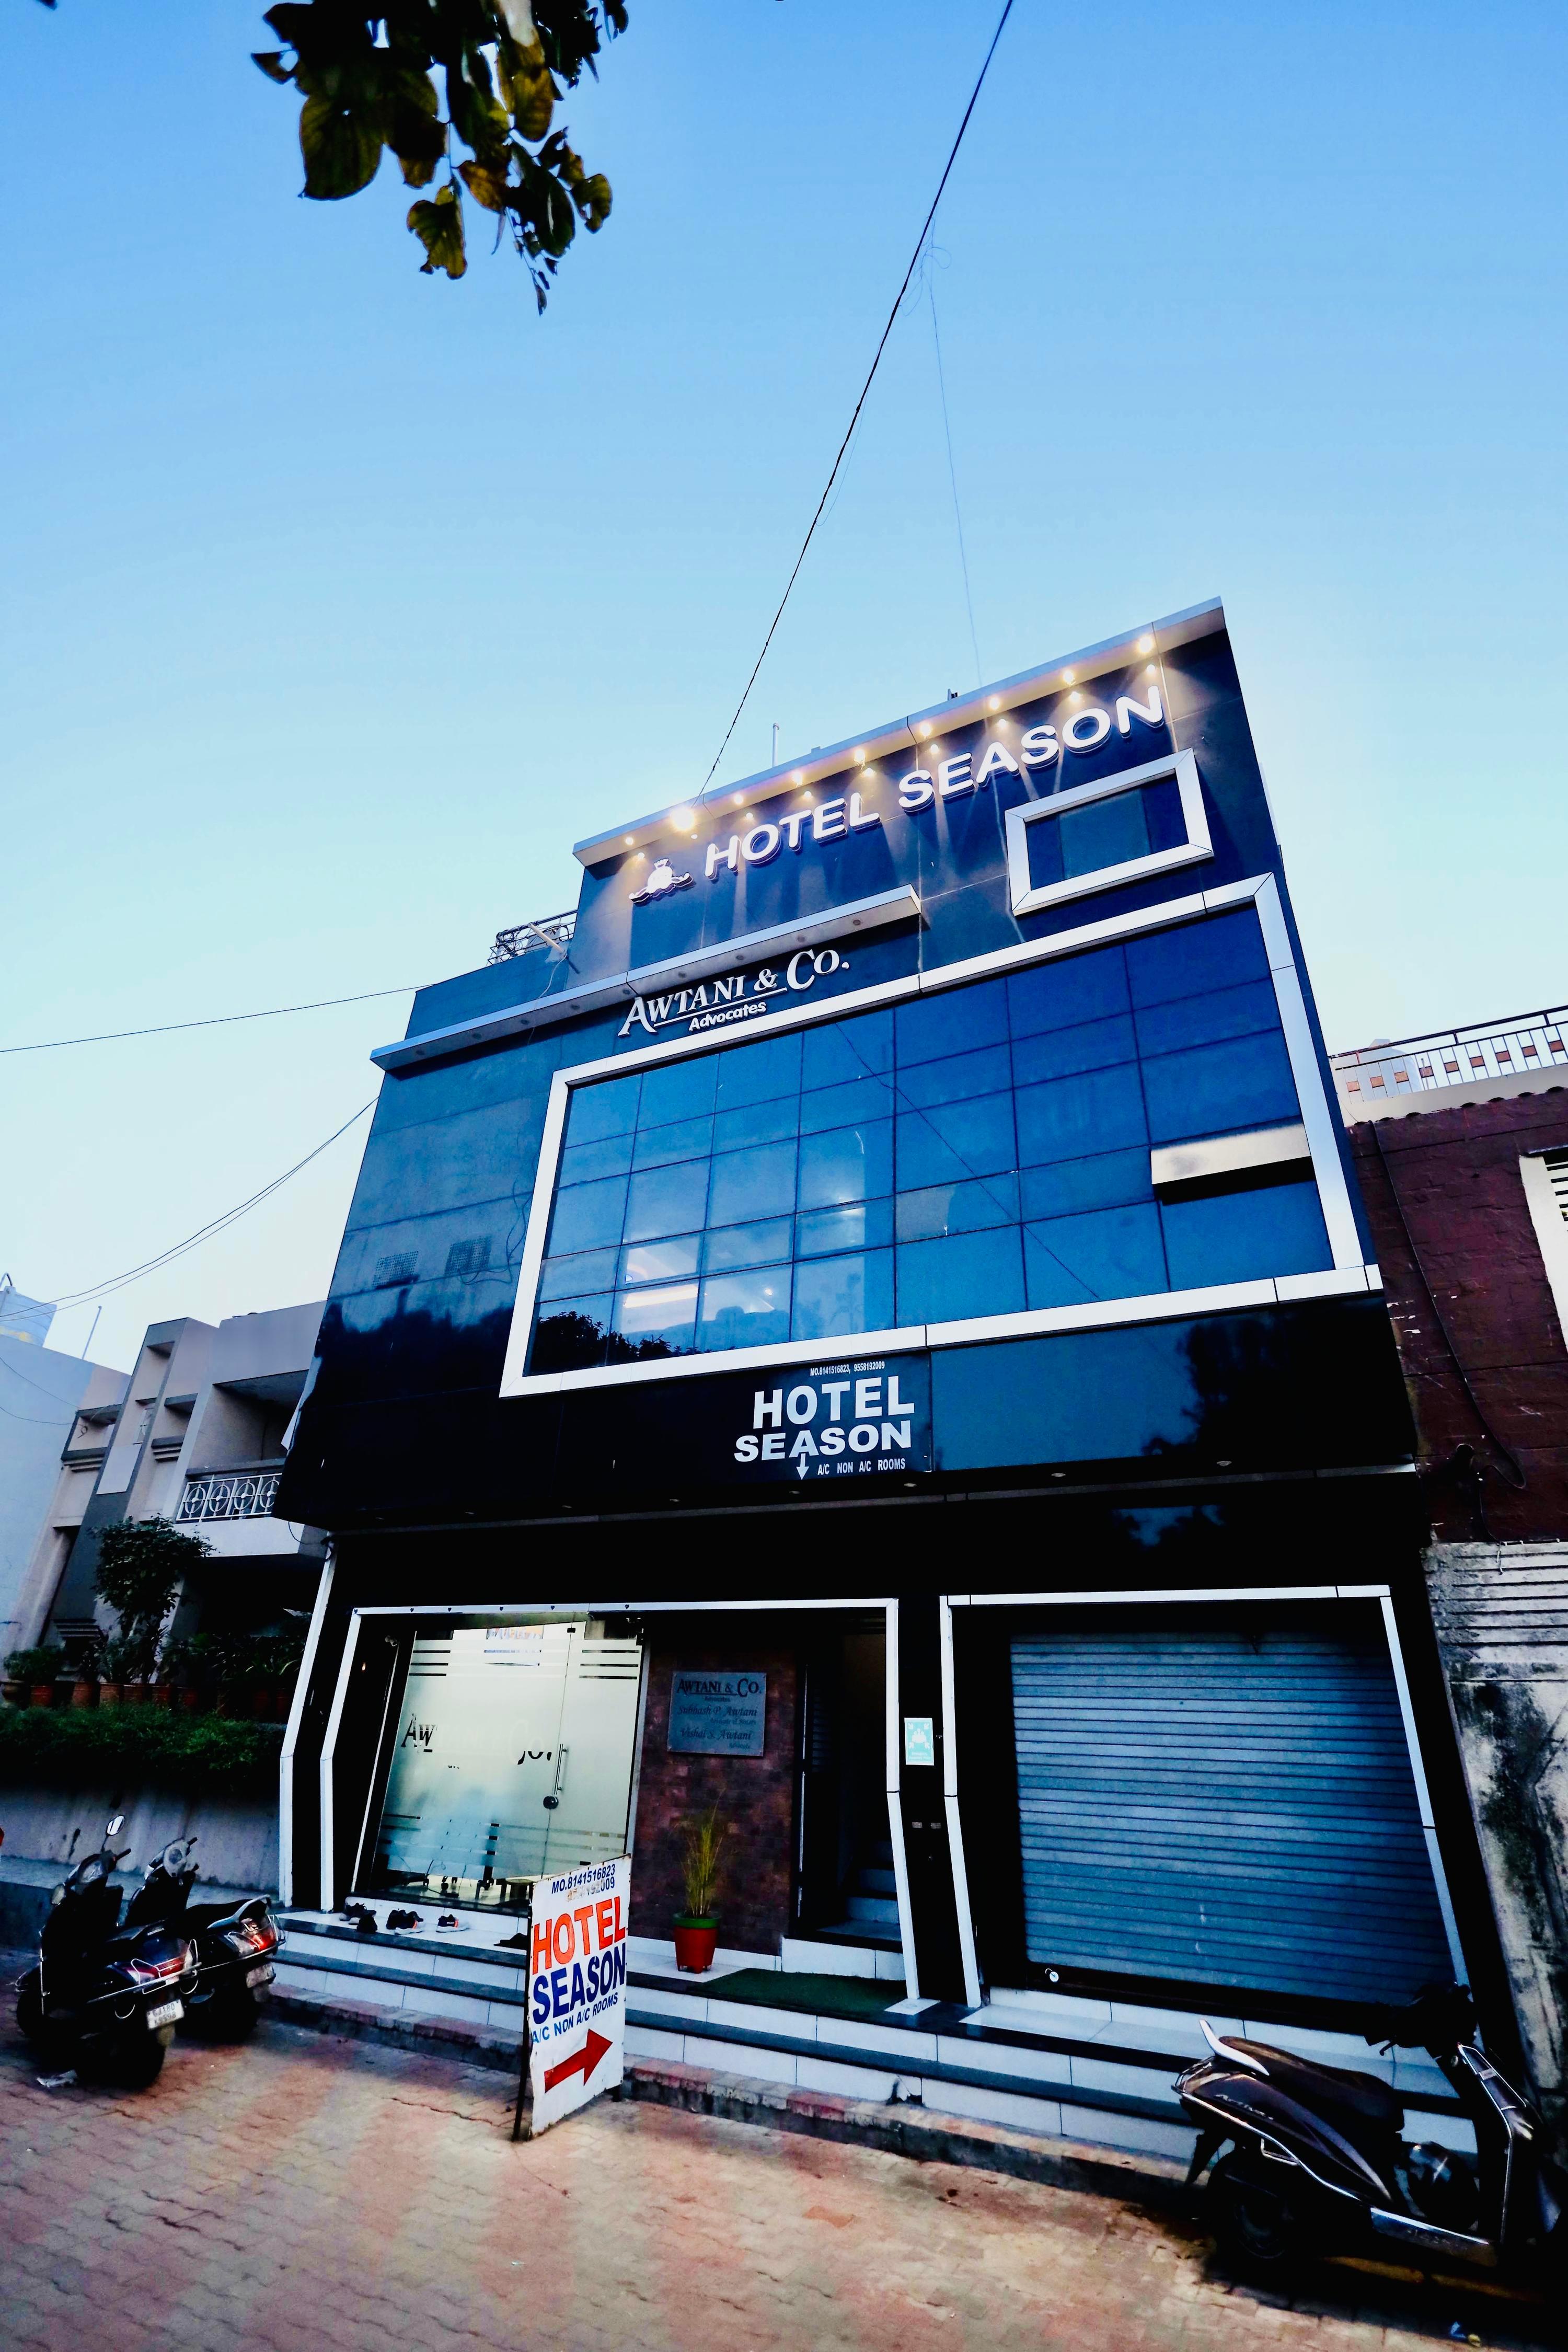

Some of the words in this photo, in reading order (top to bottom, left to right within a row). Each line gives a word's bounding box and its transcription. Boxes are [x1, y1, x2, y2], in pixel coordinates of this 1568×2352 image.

[706, 792, 880, 880] HOTEL
[898, 686, 1164, 813] SEASON
[754, 969, 778, 991] &
[689, 1001, 766, 1032] Advocates
[810, 1364, 851, 1376] MO.8141516823,
[854, 1361, 885, 1372] 9558192009
[753, 1376, 915, 1429] HOTEL
[734, 1420, 912, 1462] SEASON
[817, 1463, 830, 1476] A/C
[837, 1462, 854, 1474] NON
[859, 1460, 871, 1472] A/C
[878, 1458, 906, 1471] ROOMS
[724, 1684, 734, 1693] &
[551, 1864, 615, 1894] MO.8141516823
[532, 1896, 626, 1975] HOTEL
[532, 1942, 626, 2025] SEASON
[532, 2026, 550, 2045] A/C
[555, 2017, 575, 2038] NON
[577, 2006, 591, 2023] A/C
[593, 1992, 618, 2017] ROOMS
